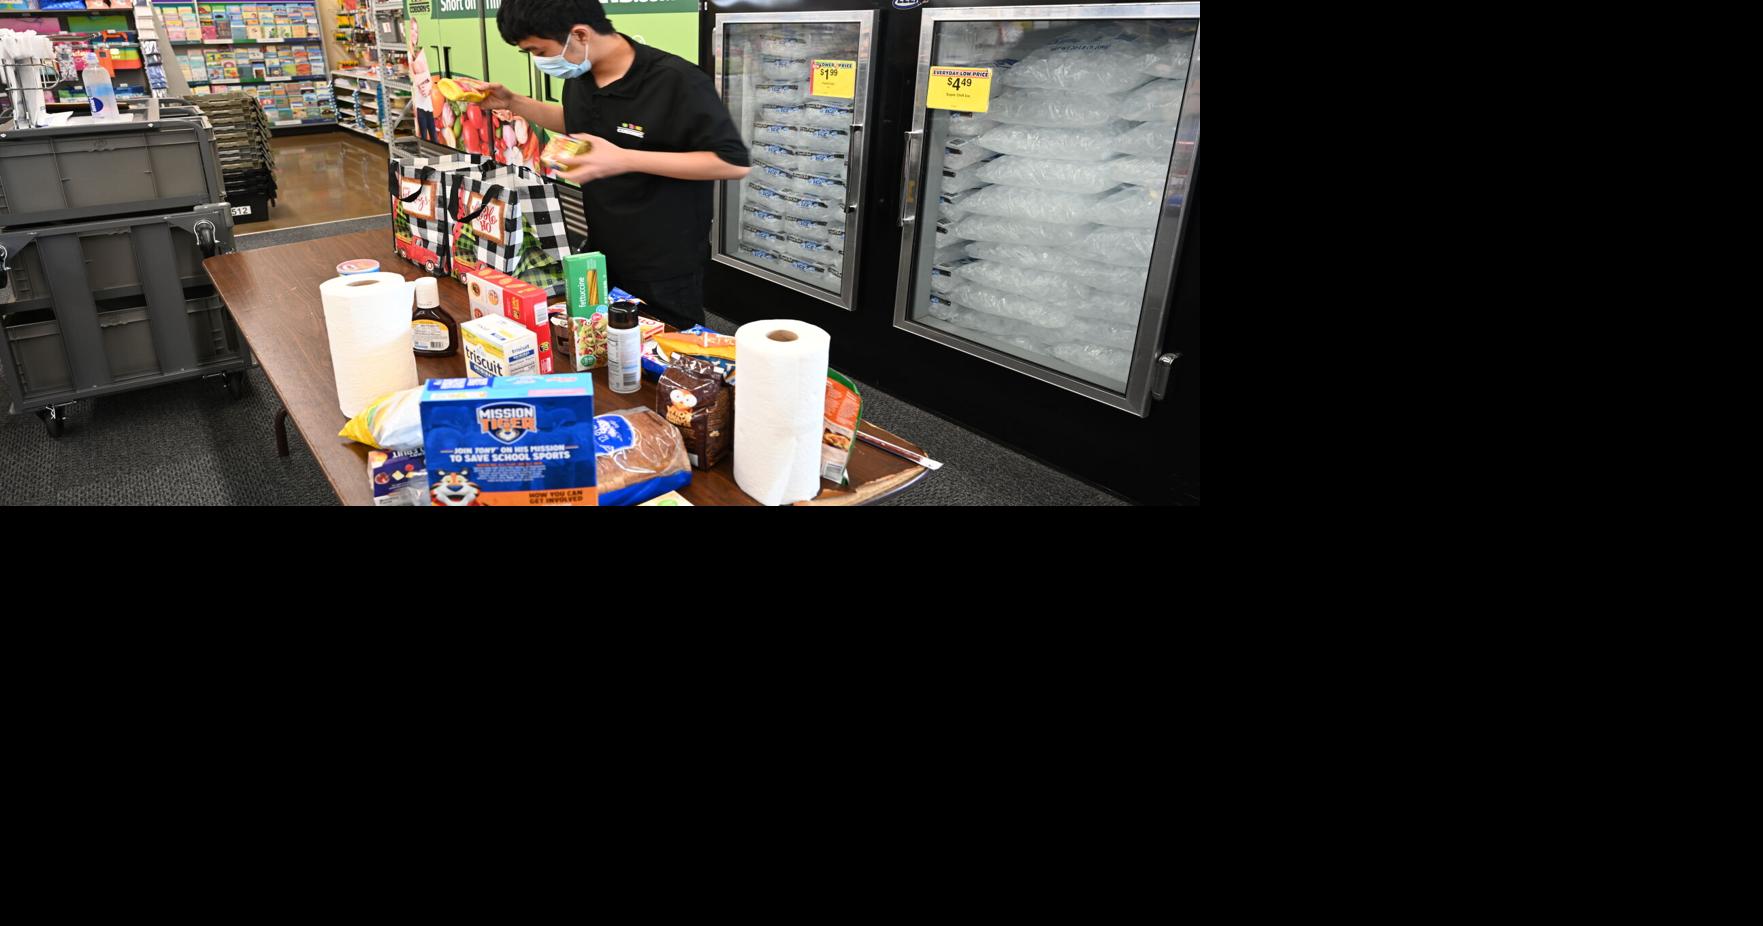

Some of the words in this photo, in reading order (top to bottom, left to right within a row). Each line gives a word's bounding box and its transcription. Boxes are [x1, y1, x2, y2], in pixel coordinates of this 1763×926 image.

[464, 0, 476, 10] on
[231, 207, 248, 216] 512
[578, 276, 587, 308] fettuccine
[465, 345, 503, 377] triscuit
[478, 407, 533, 419] MISSION
[480, 417, 535, 432] TIGER
[449, 454, 463, 463] TO
[464, 454, 490, 463] SAVE
[491, 453, 530, 462] SCHOOL
[532, 451, 571, 461] SPORTS
[545, 495, 583, 504] INVOLVED
